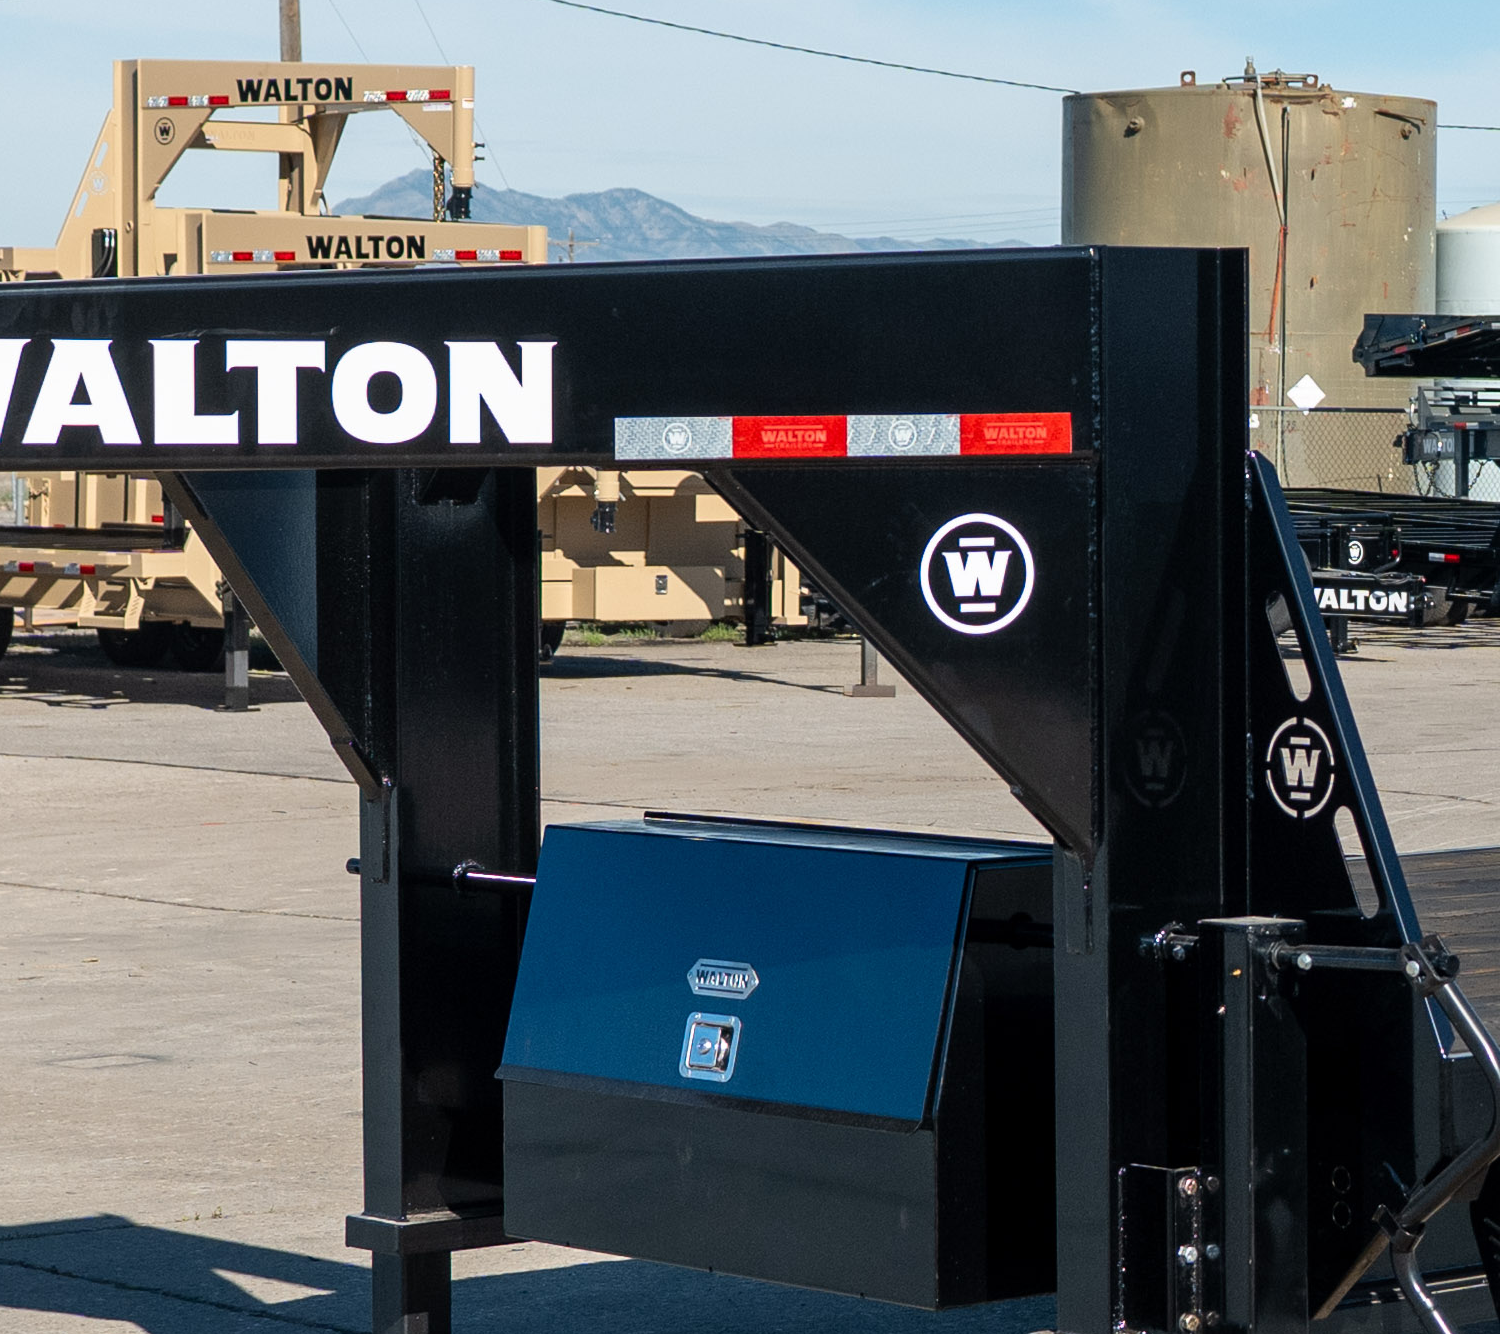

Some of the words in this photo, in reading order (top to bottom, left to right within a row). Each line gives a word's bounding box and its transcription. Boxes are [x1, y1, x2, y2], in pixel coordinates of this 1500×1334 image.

[237, 77, 353, 103] WALTON
[306, 235, 426, 261] WALTON
[760, 429, 827, 443] WALTON
[983, 427, 1047, 440] WALTON
[695, 969, 749, 989] WALTON
